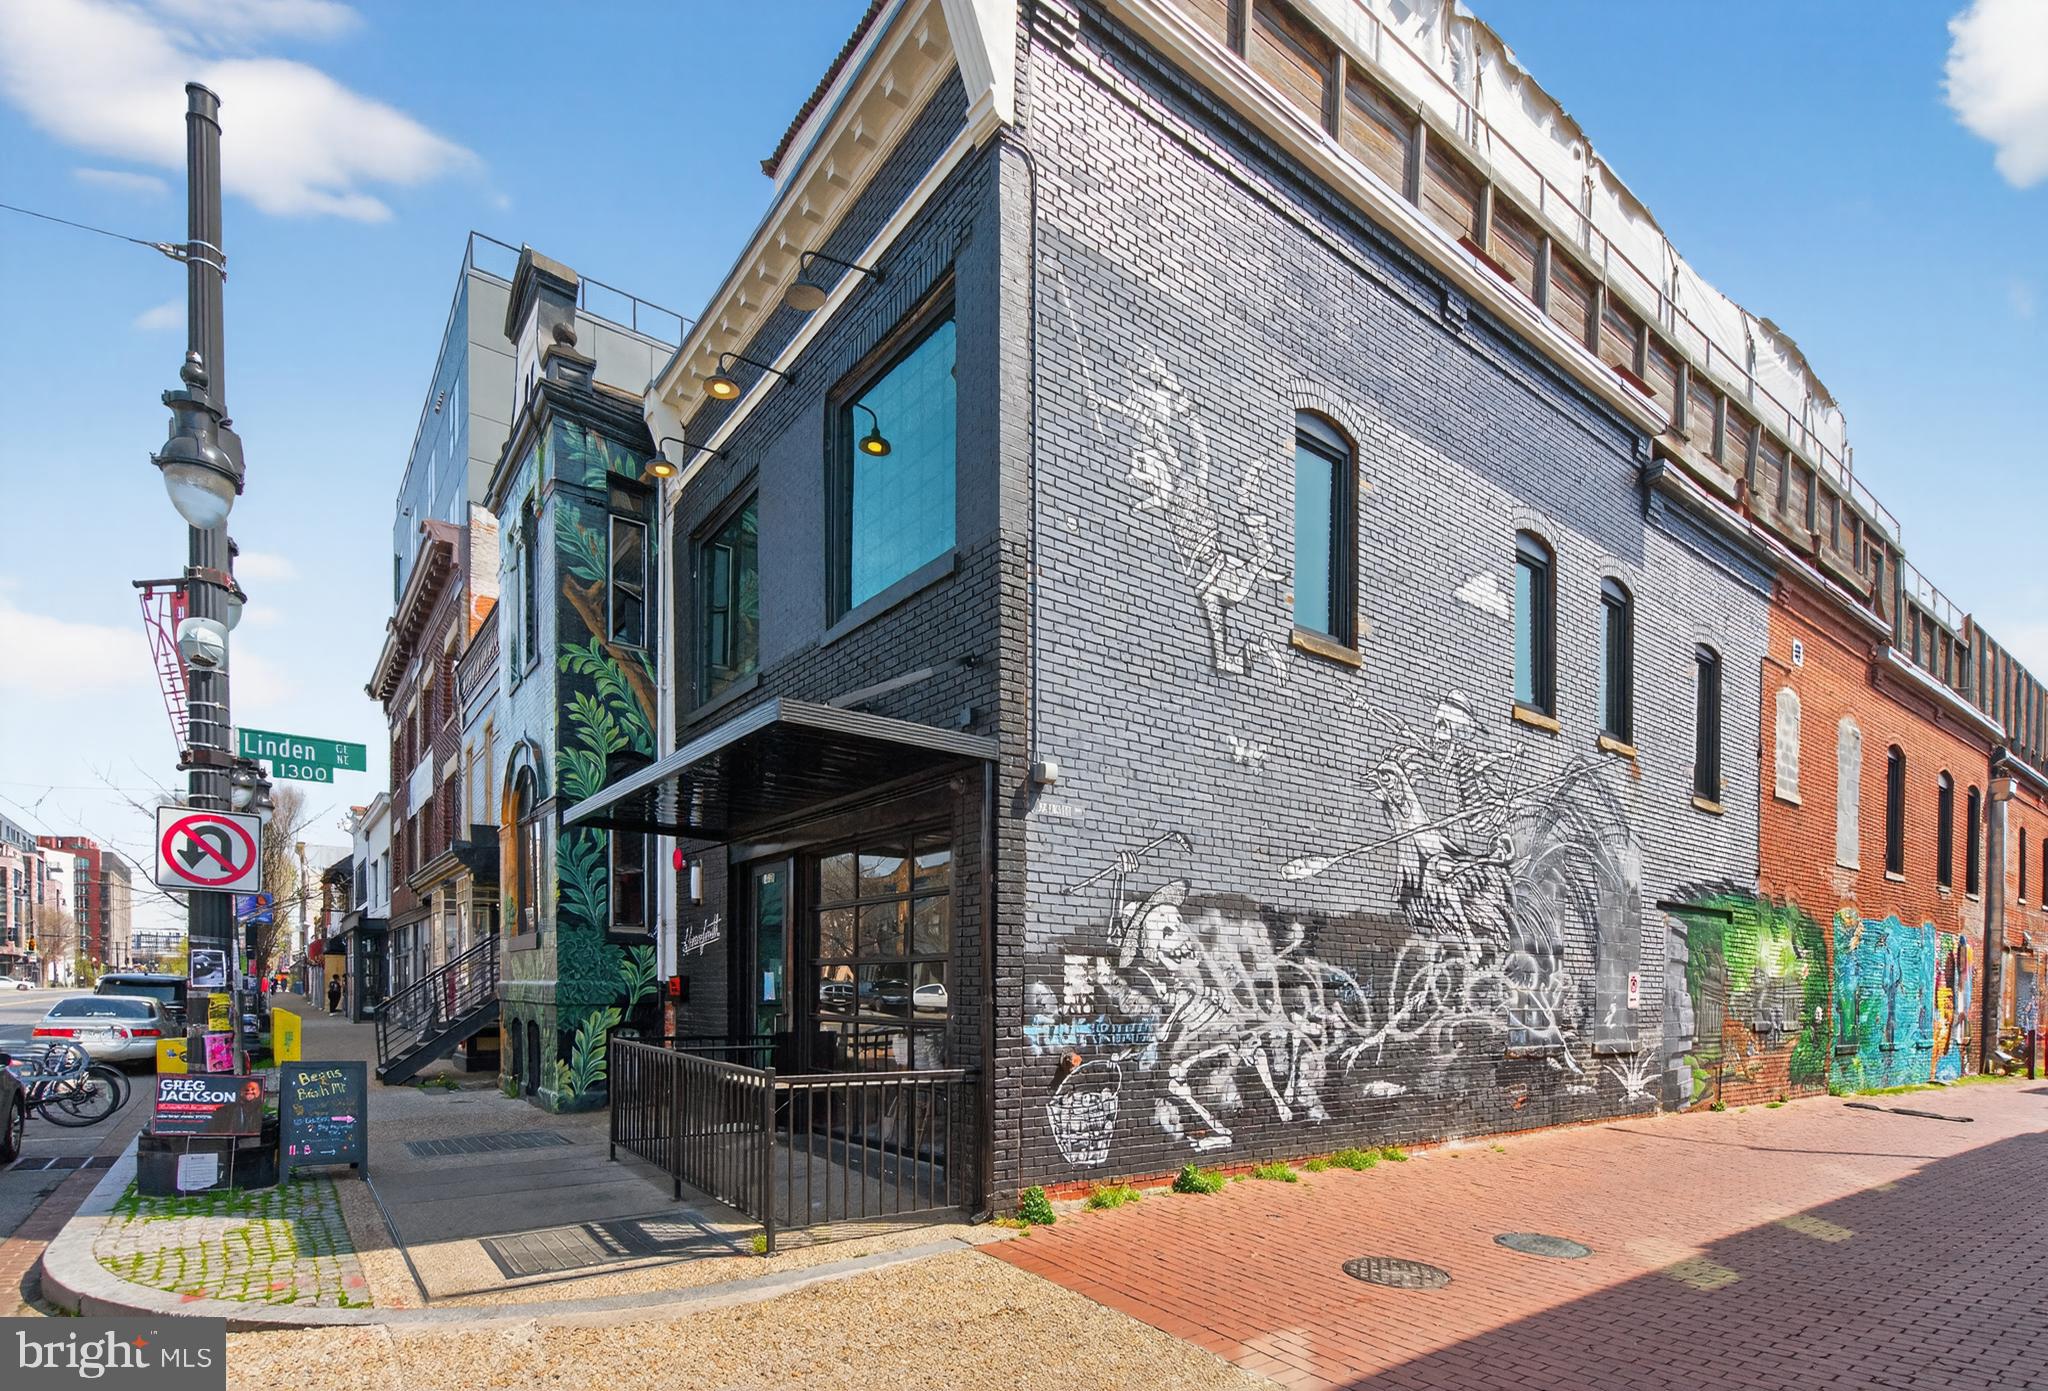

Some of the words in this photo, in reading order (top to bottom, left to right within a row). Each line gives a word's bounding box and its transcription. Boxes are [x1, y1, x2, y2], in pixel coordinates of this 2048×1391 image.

[244, 732, 316, 761] Linden
[280, 763, 327, 781] 1300
[160, 1079, 206, 1092] GREG
[298, 1069, 343, 1086] Beans
[158, 1090, 237, 1103] JACKSON
